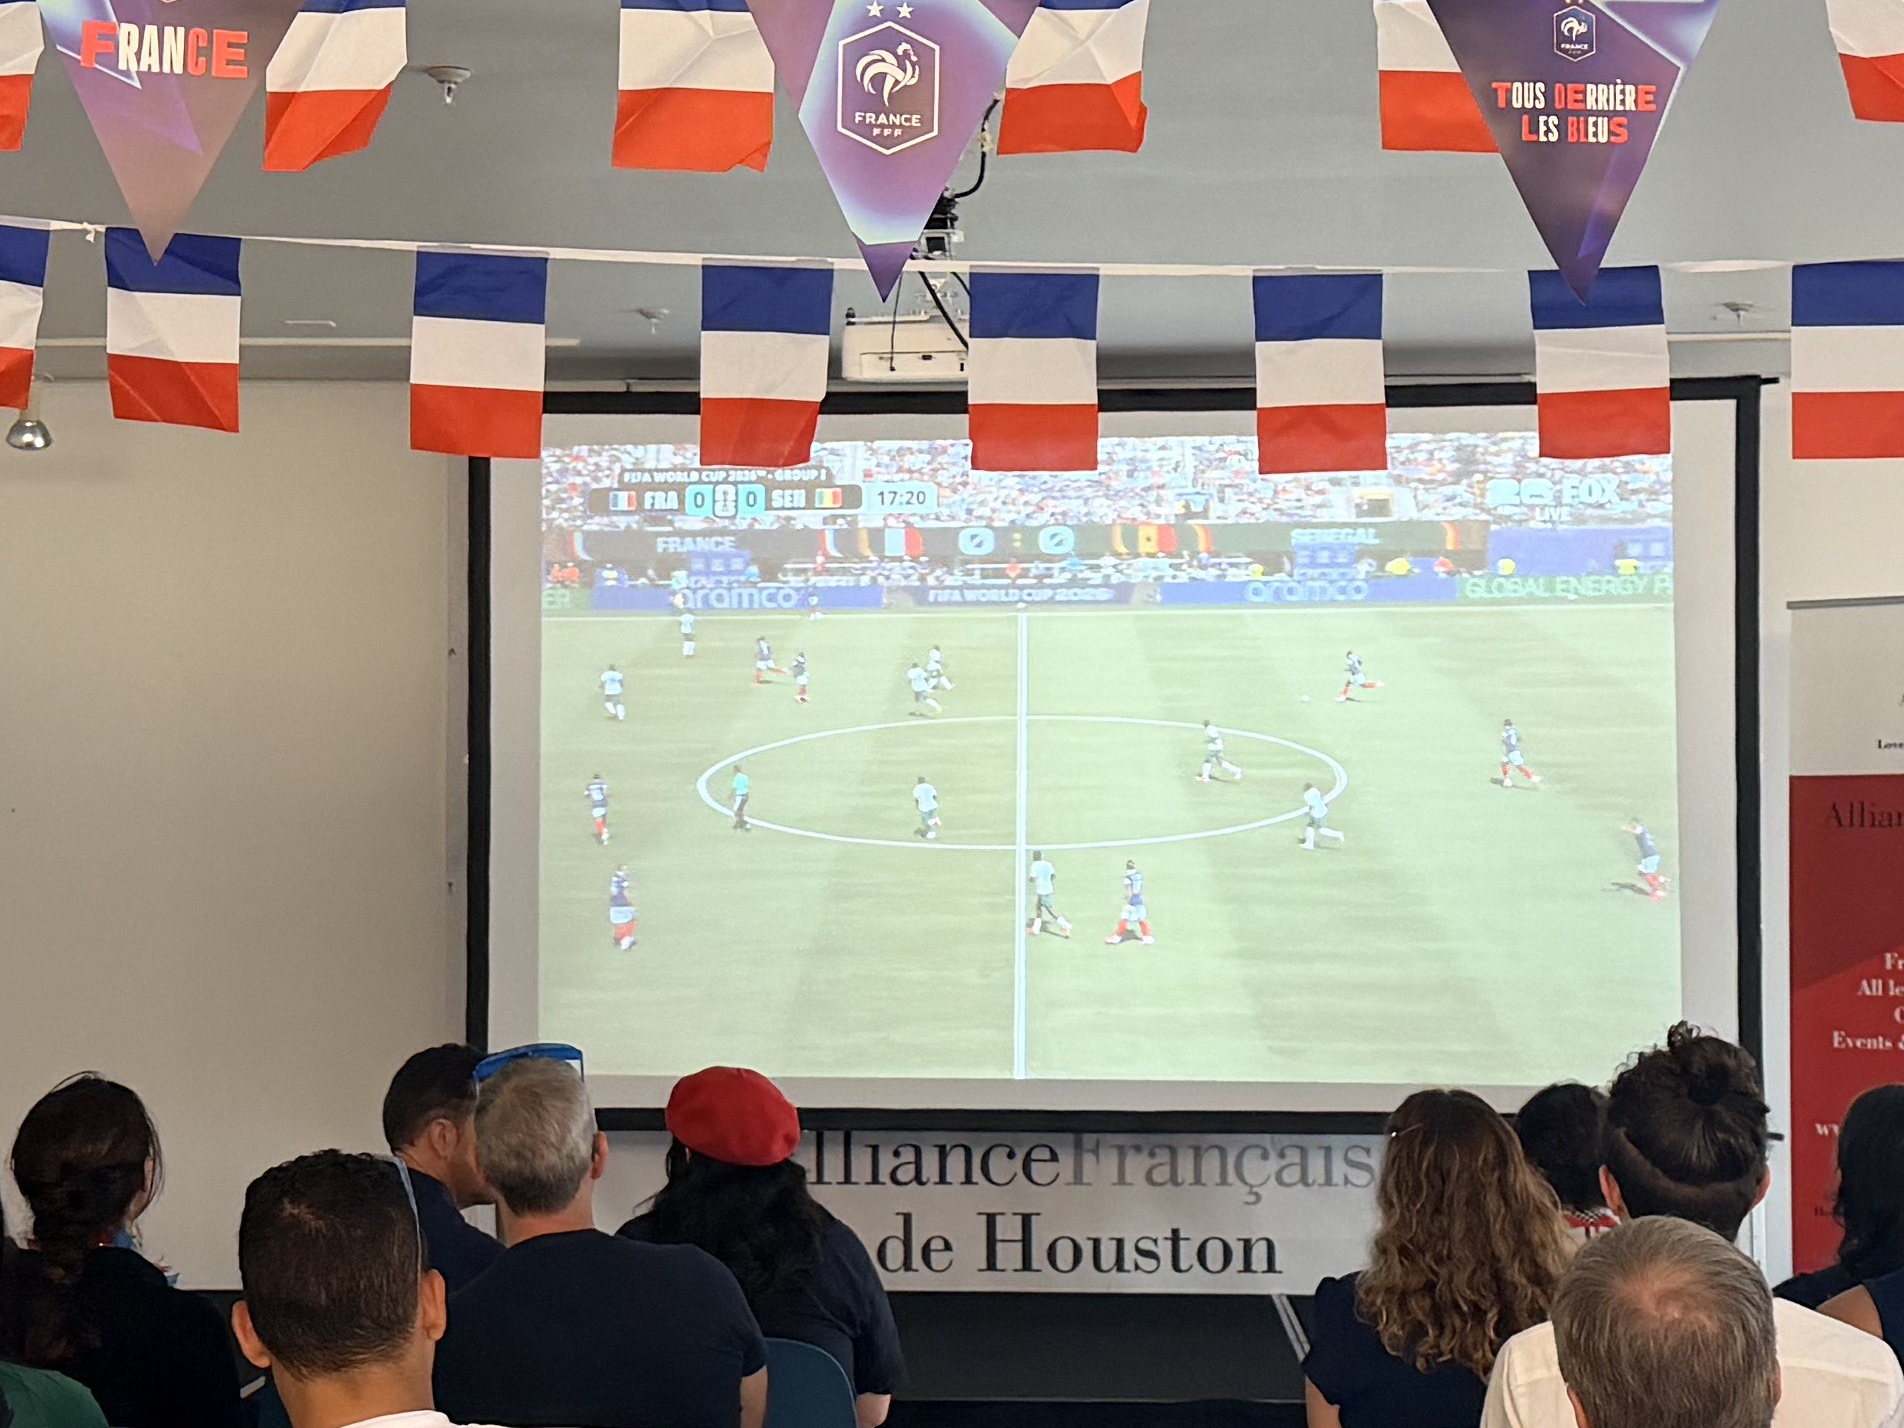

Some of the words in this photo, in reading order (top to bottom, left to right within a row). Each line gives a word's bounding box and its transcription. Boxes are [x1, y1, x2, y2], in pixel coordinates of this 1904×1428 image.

[80, 20, 250, 79] FRANCE
[1491, 81, 1545, 111] TOUS
[1554, 79, 1656, 112] DERRIÈRE
[855, 112, 922, 127] FRANCE
[1521, 114, 1559, 142] LES
[1567, 115, 1628, 143] BLEUS
[624, 471, 655, 483] FIFA
[657, 470, 699, 483] WORLD
[702, 470, 726, 482] CUP
[644, 491, 679, 511] FRA
[693, 492, 705, 509] 0
[746, 491, 757, 508] 0
[771, 490, 806, 509] SEN
[877, 491, 927, 507] 17:20
[1563, 477, 1620, 505] FOX
[1534, 506, 1571, 521] LIVE
[656, 536, 737, 553] FRANCE
[1290, 528, 1381, 545] SENEGAL
[928, 589, 963, 602] FIFA
[966, 589, 1014, 602] WORLD
[1018, 589, 1051, 602] CUP
[1245, 581, 1369, 602] aramco
[1465, 577, 1550, 600] GLOBAL
[1556, 575, 1649, 598] ENERGY
[1857, 979, 1883, 997] All
[1832, 1030, 1892, 1050] Events
[877, 1211, 954, 1274] de
[977, 1211, 1284, 1275] Houston
